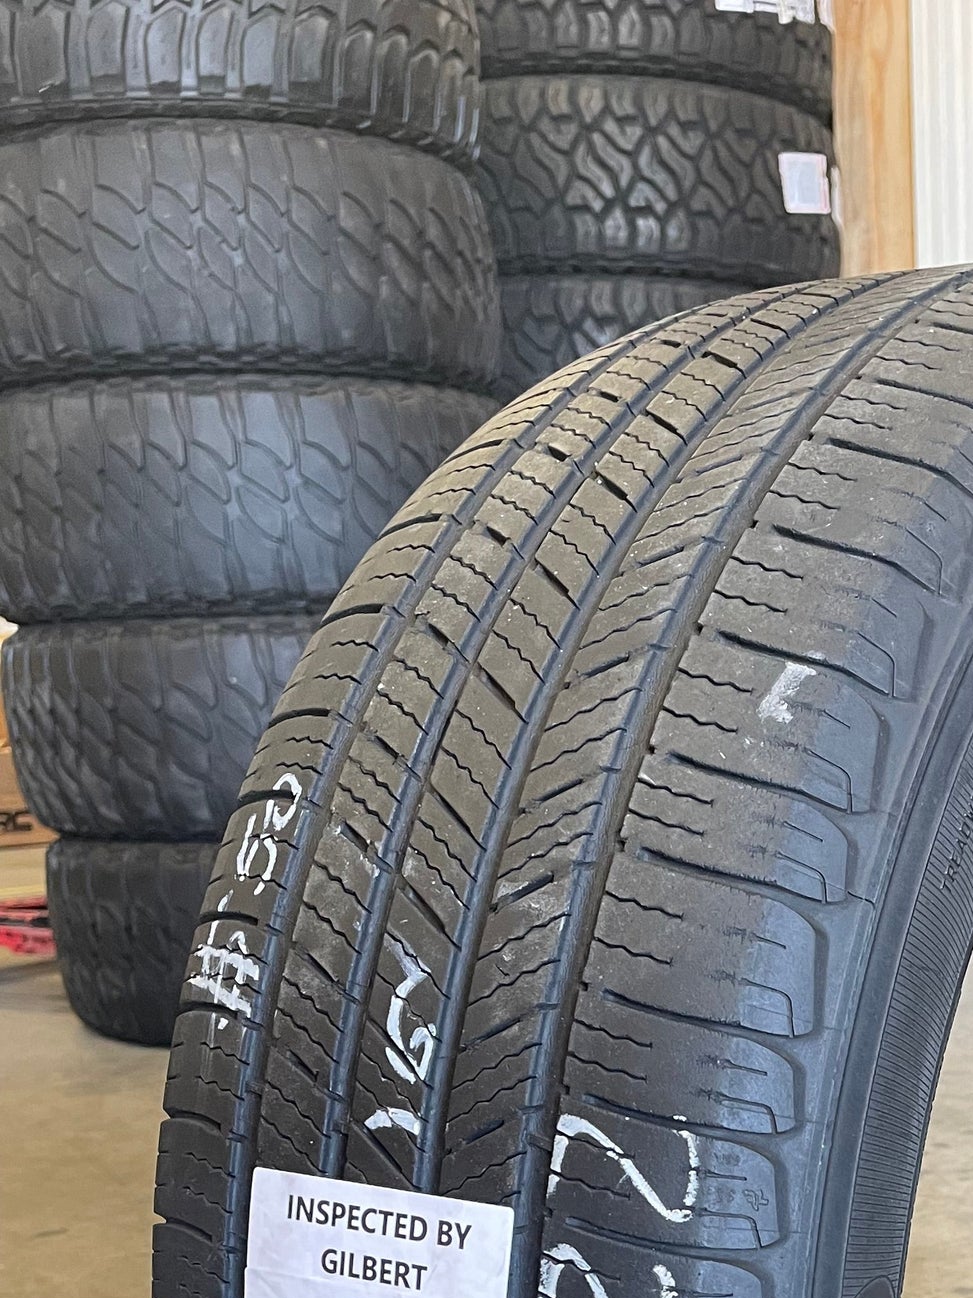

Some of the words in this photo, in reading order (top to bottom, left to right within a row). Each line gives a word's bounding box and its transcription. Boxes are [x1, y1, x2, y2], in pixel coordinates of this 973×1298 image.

[287, 1194, 428, 1242] INSPECTED
[436, 1221, 472, 1250] BY
[321, 1248, 428, 1290] GILBERT
